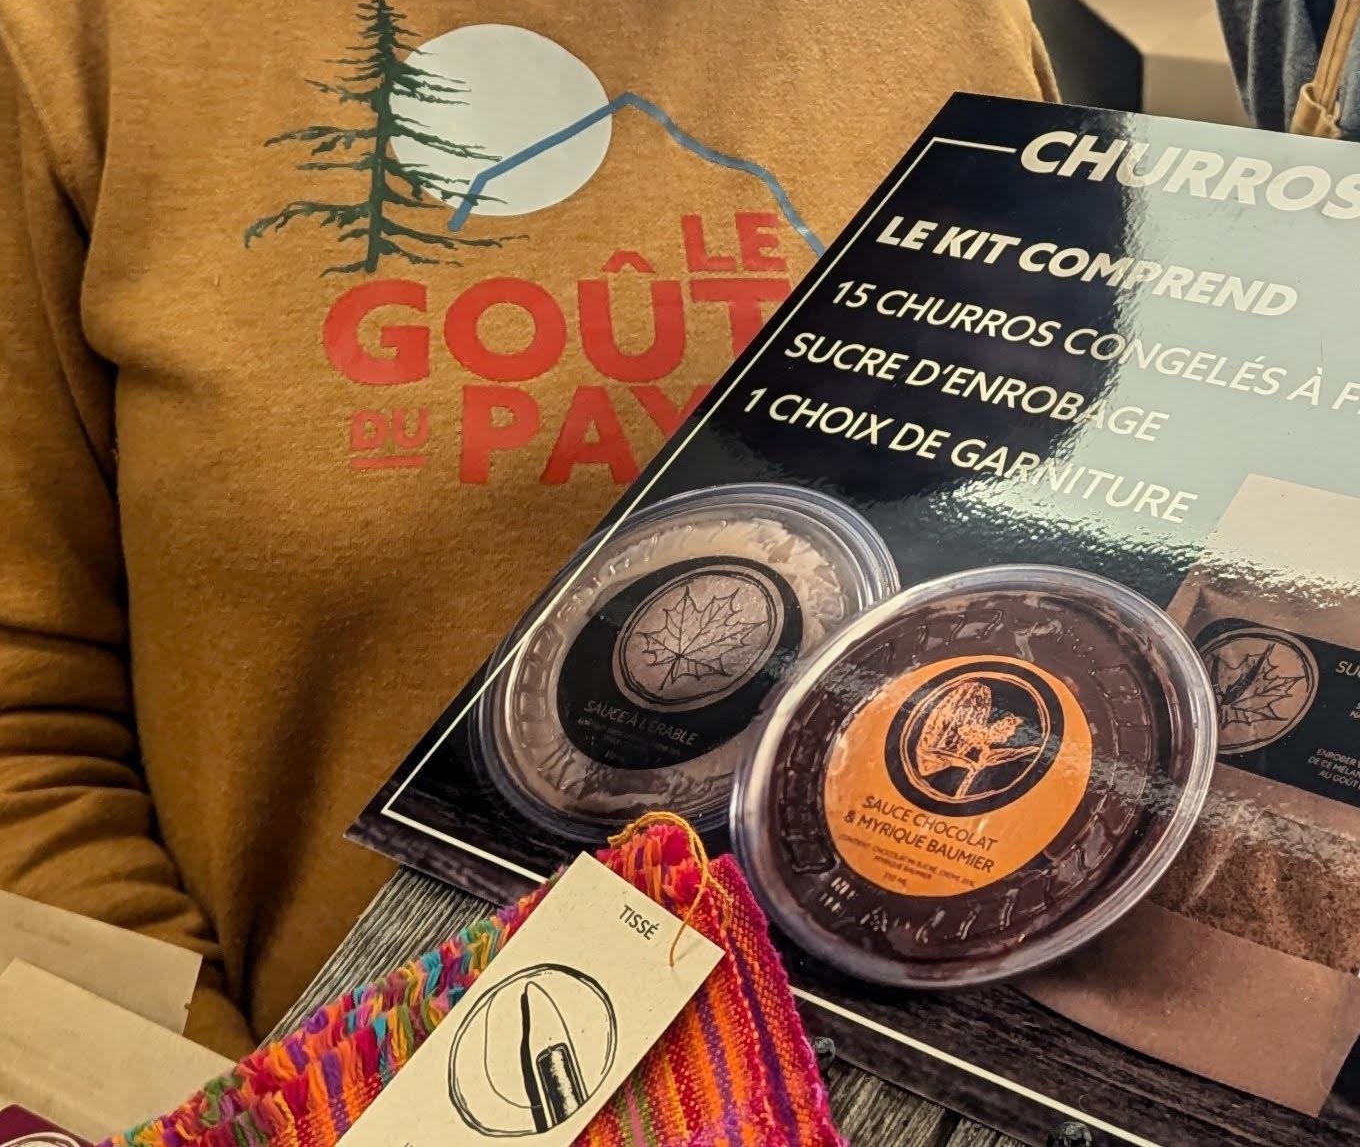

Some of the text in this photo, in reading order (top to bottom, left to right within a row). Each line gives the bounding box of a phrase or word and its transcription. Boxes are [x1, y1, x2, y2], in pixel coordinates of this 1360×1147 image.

[682, 213, 787, 273] LE
[876, 215, 1299, 319] LE KIT COMPREND
[322, 251, 792, 386] GOÛT
[832, 280, 872, 309] 15
[876, 288, 1062, 349] CHURROS
[1070, 327, 1288, 397] CONGELÉS
[1289, 365, 1329, 406] À
[784, 331, 1170, 443] SUCRE D'ENROBAGE
[350, 409, 430, 452] DU
[743, 388, 1200, 525] 1 CHOIX DE GARNITURE
[584, 699, 628, 723] SAUCE
[1308, 756, 1320, 766] DE
[844, 810, 856, 823] &
[857, 814, 927, 849] MYRIQUE
[926, 839, 995, 873] BAUMIER
[862, 795, 998, 851] SAUCE CHOCOLAT
[619, 904, 661, 941] TISSÉ
